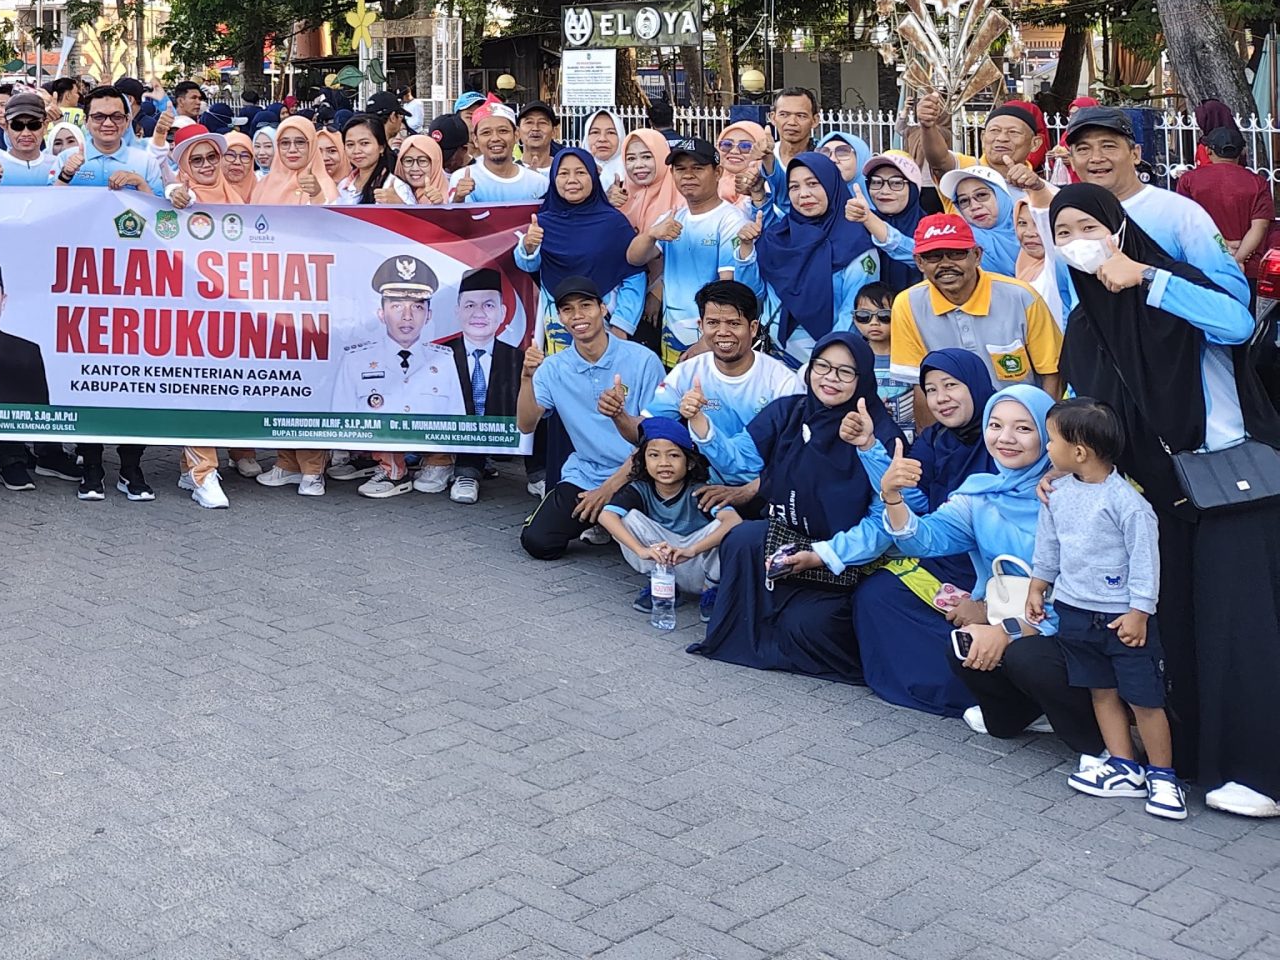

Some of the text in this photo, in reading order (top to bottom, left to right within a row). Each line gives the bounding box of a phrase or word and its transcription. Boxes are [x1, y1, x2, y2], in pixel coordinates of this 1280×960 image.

[600, 7, 697, 39] ELOYA
[51, 246, 335, 302] JALAN SEHAT
[55, 305, 330, 361] KERUKUNAN
[81, 364, 302, 381] KANTOR KEMENTERIAN AGAMA
[70, 380, 312, 397] KABUPATEN SIDENRENG RAPPANG
[0, 410, 10, 420] ALI
[11, 410, 33, 421] YAFID,
[264, 417, 271, 427] H.
[272, 429, 373, 439] BUPATI SIDENRENG RAPPANG
[389, 420, 400, 430] Dr.
[402, 420, 410, 430] H.
[412, 421, 456, 431] MUHAMMAD
[458, 422, 477, 432] IDRIS
[479, 422, 508, 433] USMAN,
[425, 433, 515, 443] KAKAN KEMENAG SIDRAP
